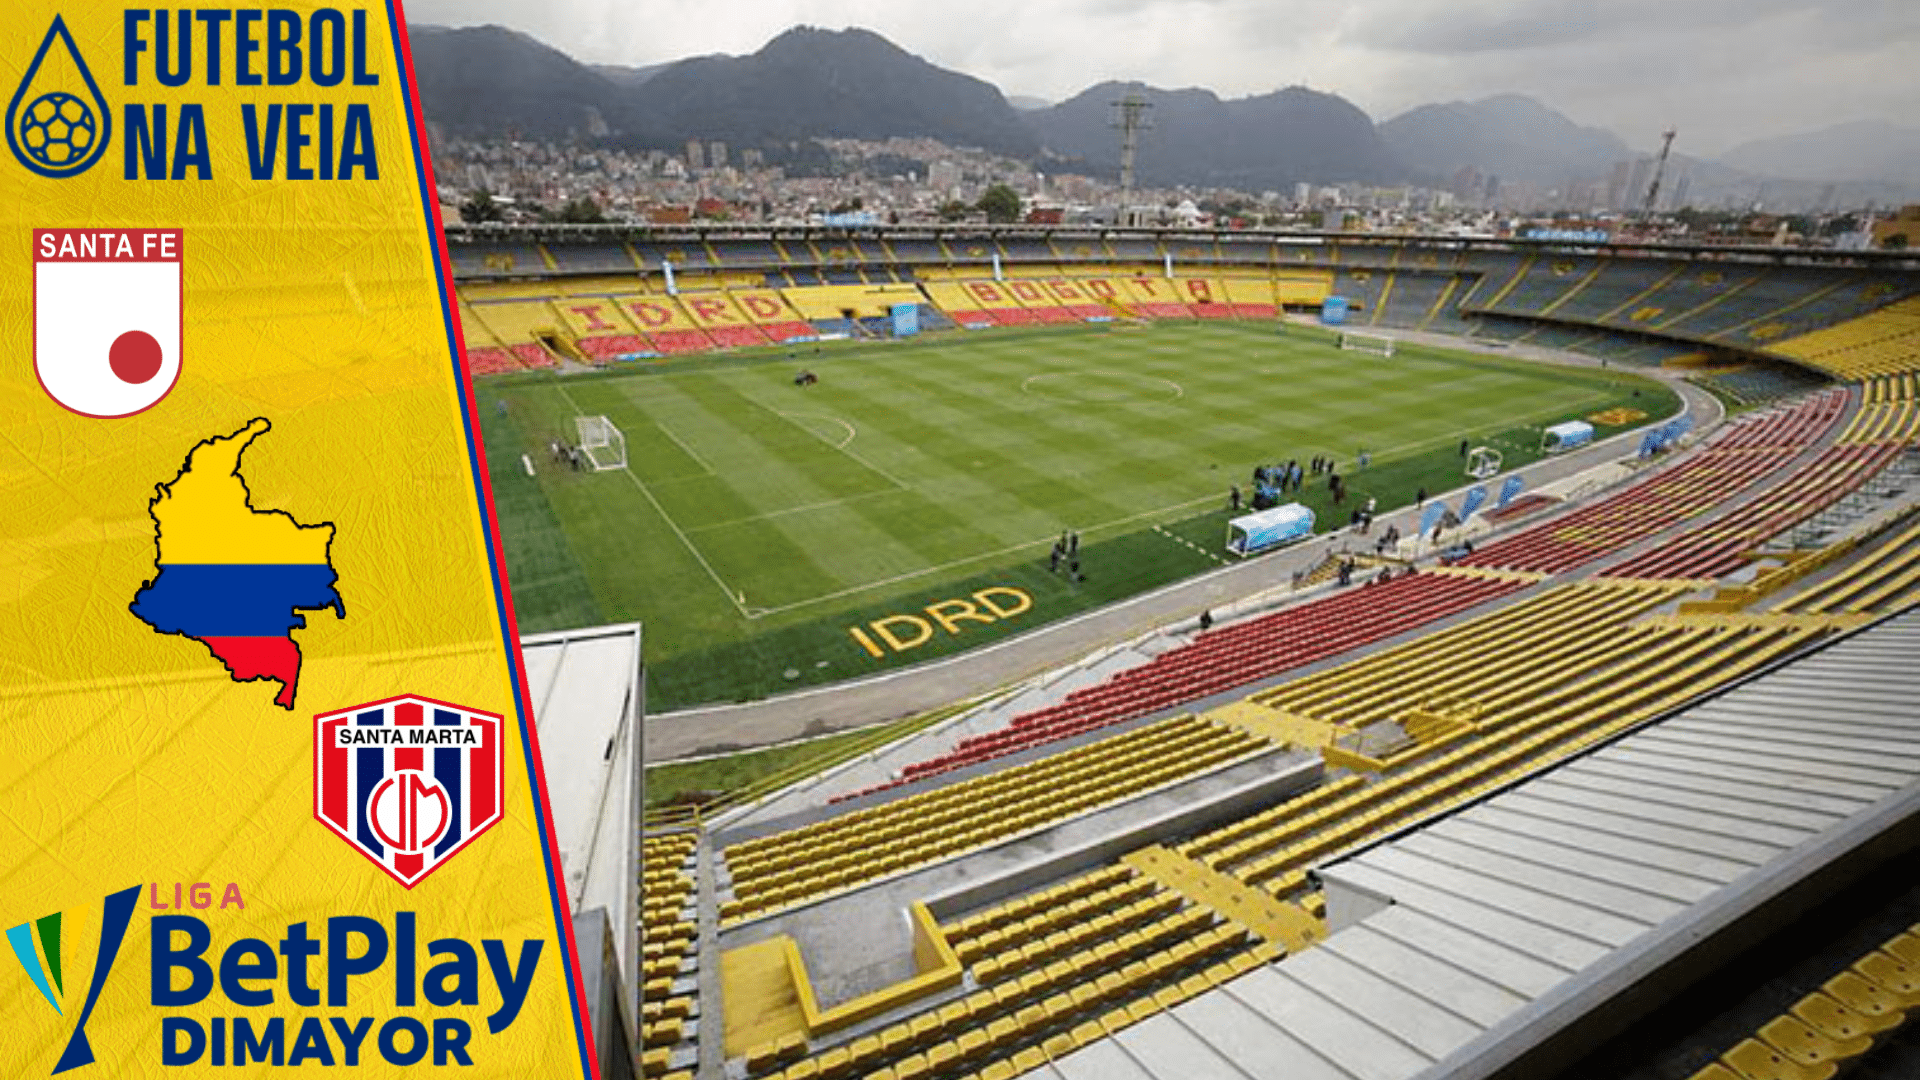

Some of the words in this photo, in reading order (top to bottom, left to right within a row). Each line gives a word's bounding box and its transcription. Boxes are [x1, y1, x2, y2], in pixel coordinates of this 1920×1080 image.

[970, 278, 1212, 302] BOGOTA
[570, 295, 783, 332] IDRD
[849, 585, 1034, 659] IDRD
